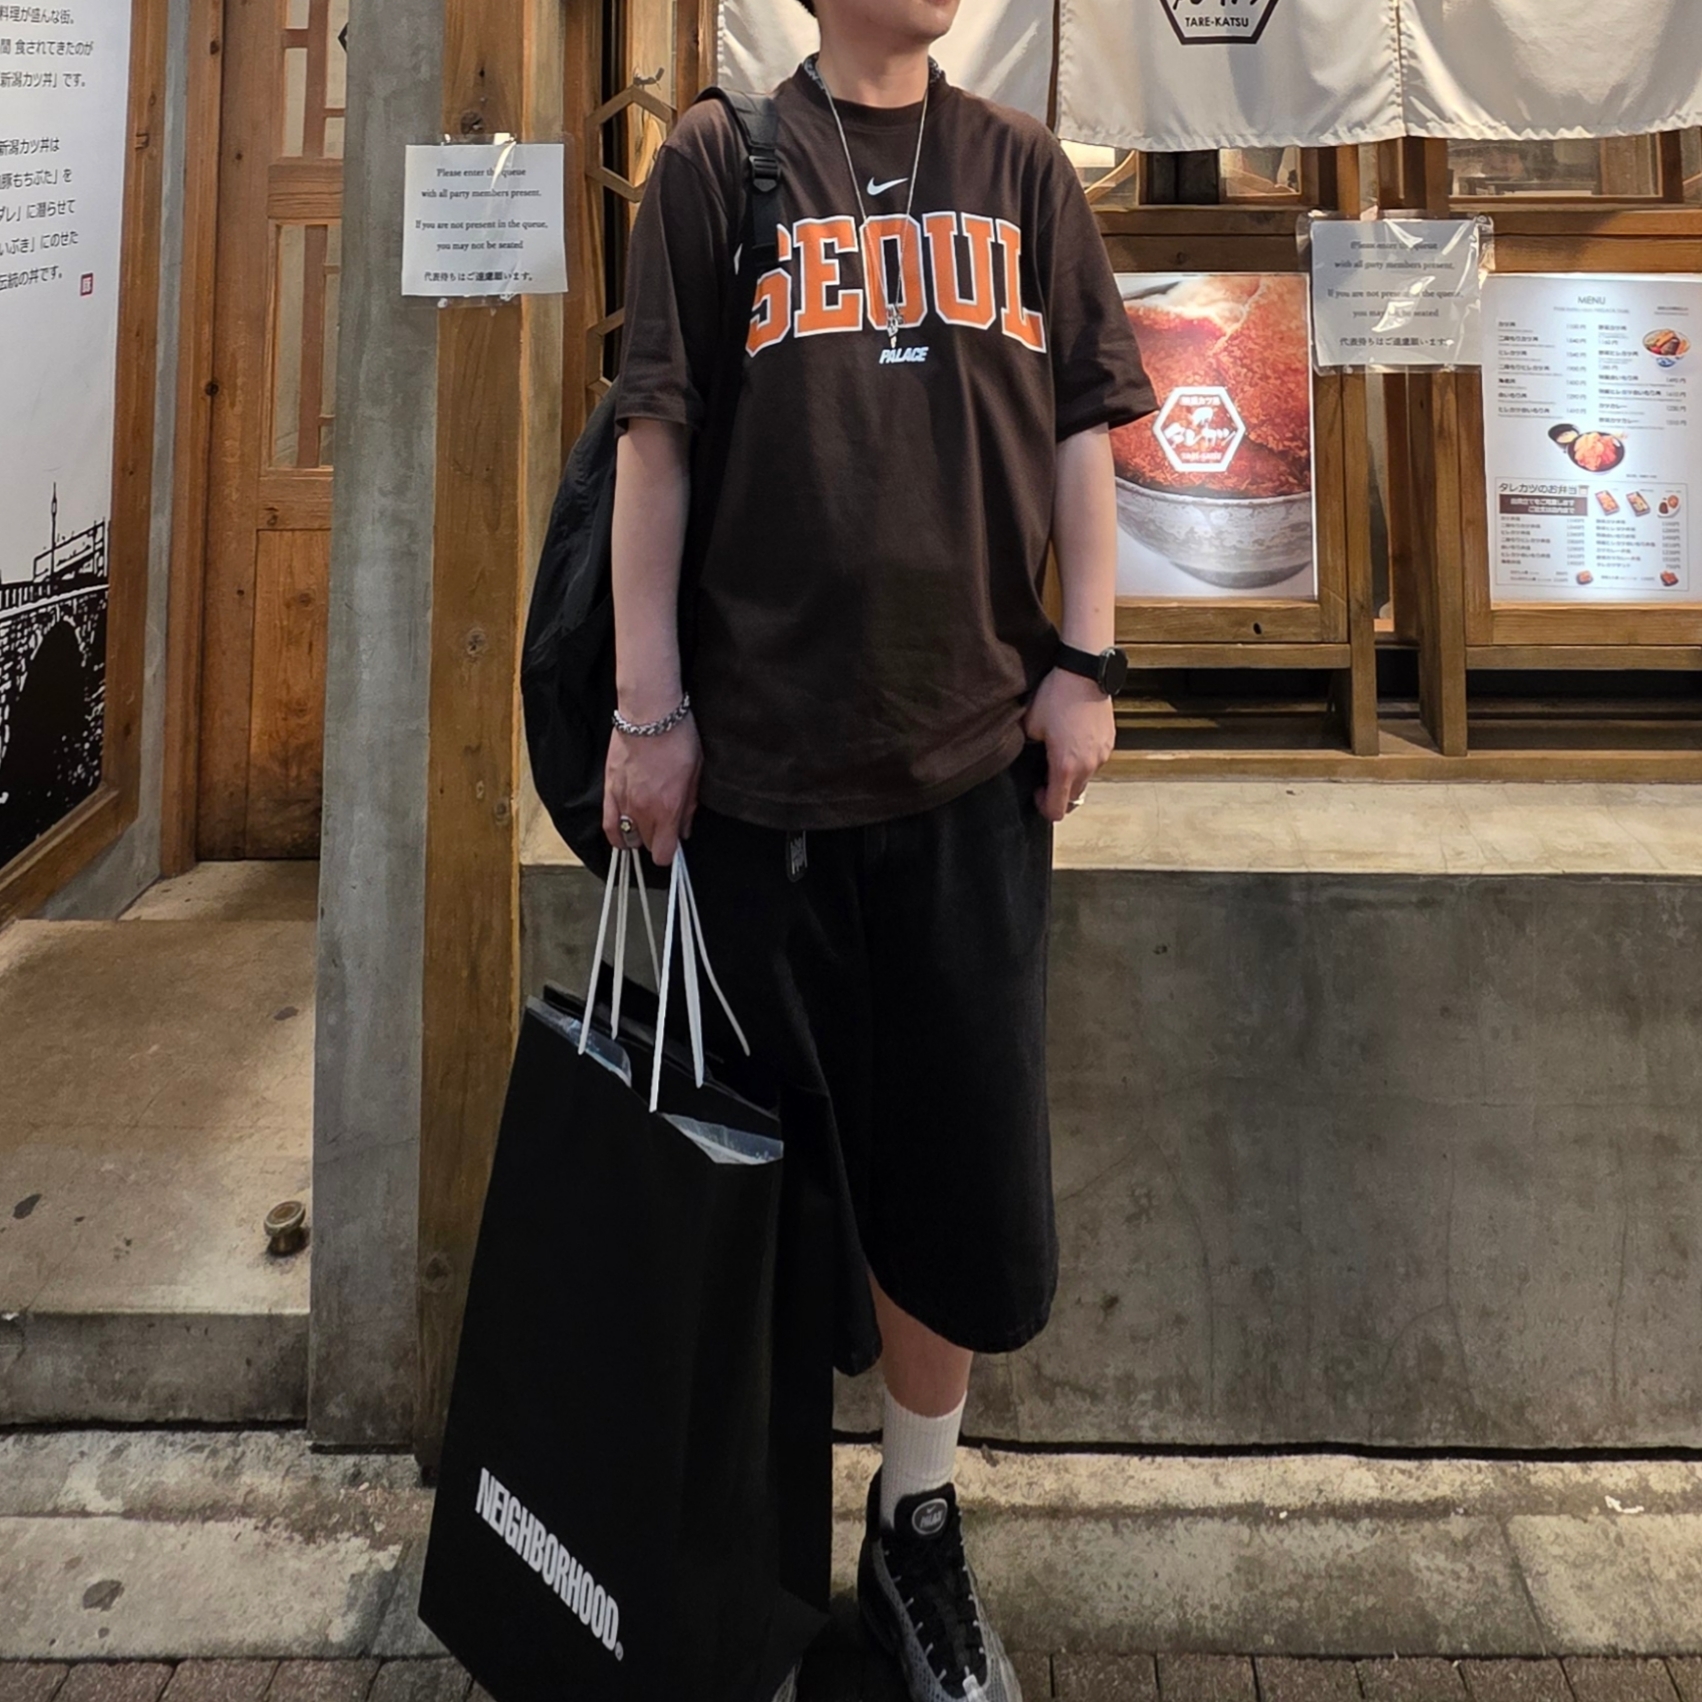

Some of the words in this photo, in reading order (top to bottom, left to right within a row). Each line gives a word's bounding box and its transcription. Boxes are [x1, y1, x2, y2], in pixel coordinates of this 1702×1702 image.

[1184, 16, 1250, 28] TARE-KATSU
[436, 168, 461, 177] Please
[463, 169, 484, 177] enter
[501, 169, 526, 178] queue
[421, 189, 437, 198] with
[438, 189, 448, 198] all
[449, 190, 470, 199] party
[472, 188, 509, 197] members
[415, 220, 422, 229] If
[422, 222, 435, 231] you
[450, 221, 464, 229] not
[465, 221, 496, 231] present
[498, 220, 506, 228] in
[508, 220, 520, 228] the
[436, 242, 451, 251] you
[452, 242, 469, 251] may
[471, 241, 484, 249] not
[486, 240, 496, 249] be
[1334, 260, 1352, 268] with
[1354, 260, 1363, 268] all
[1386, 260, 1421, 269] members
[744, 211, 1048, 357] SEOUL
[1335, 290, 1350, 299] you
[1422, 289, 1434, 297] the
[1578, 296, 1606, 305] MENU
[1352, 310, 1367, 319] you
[879, 347, 929, 364] PALACE
[1499, 483, 1577, 494] タレカツのお弁当
